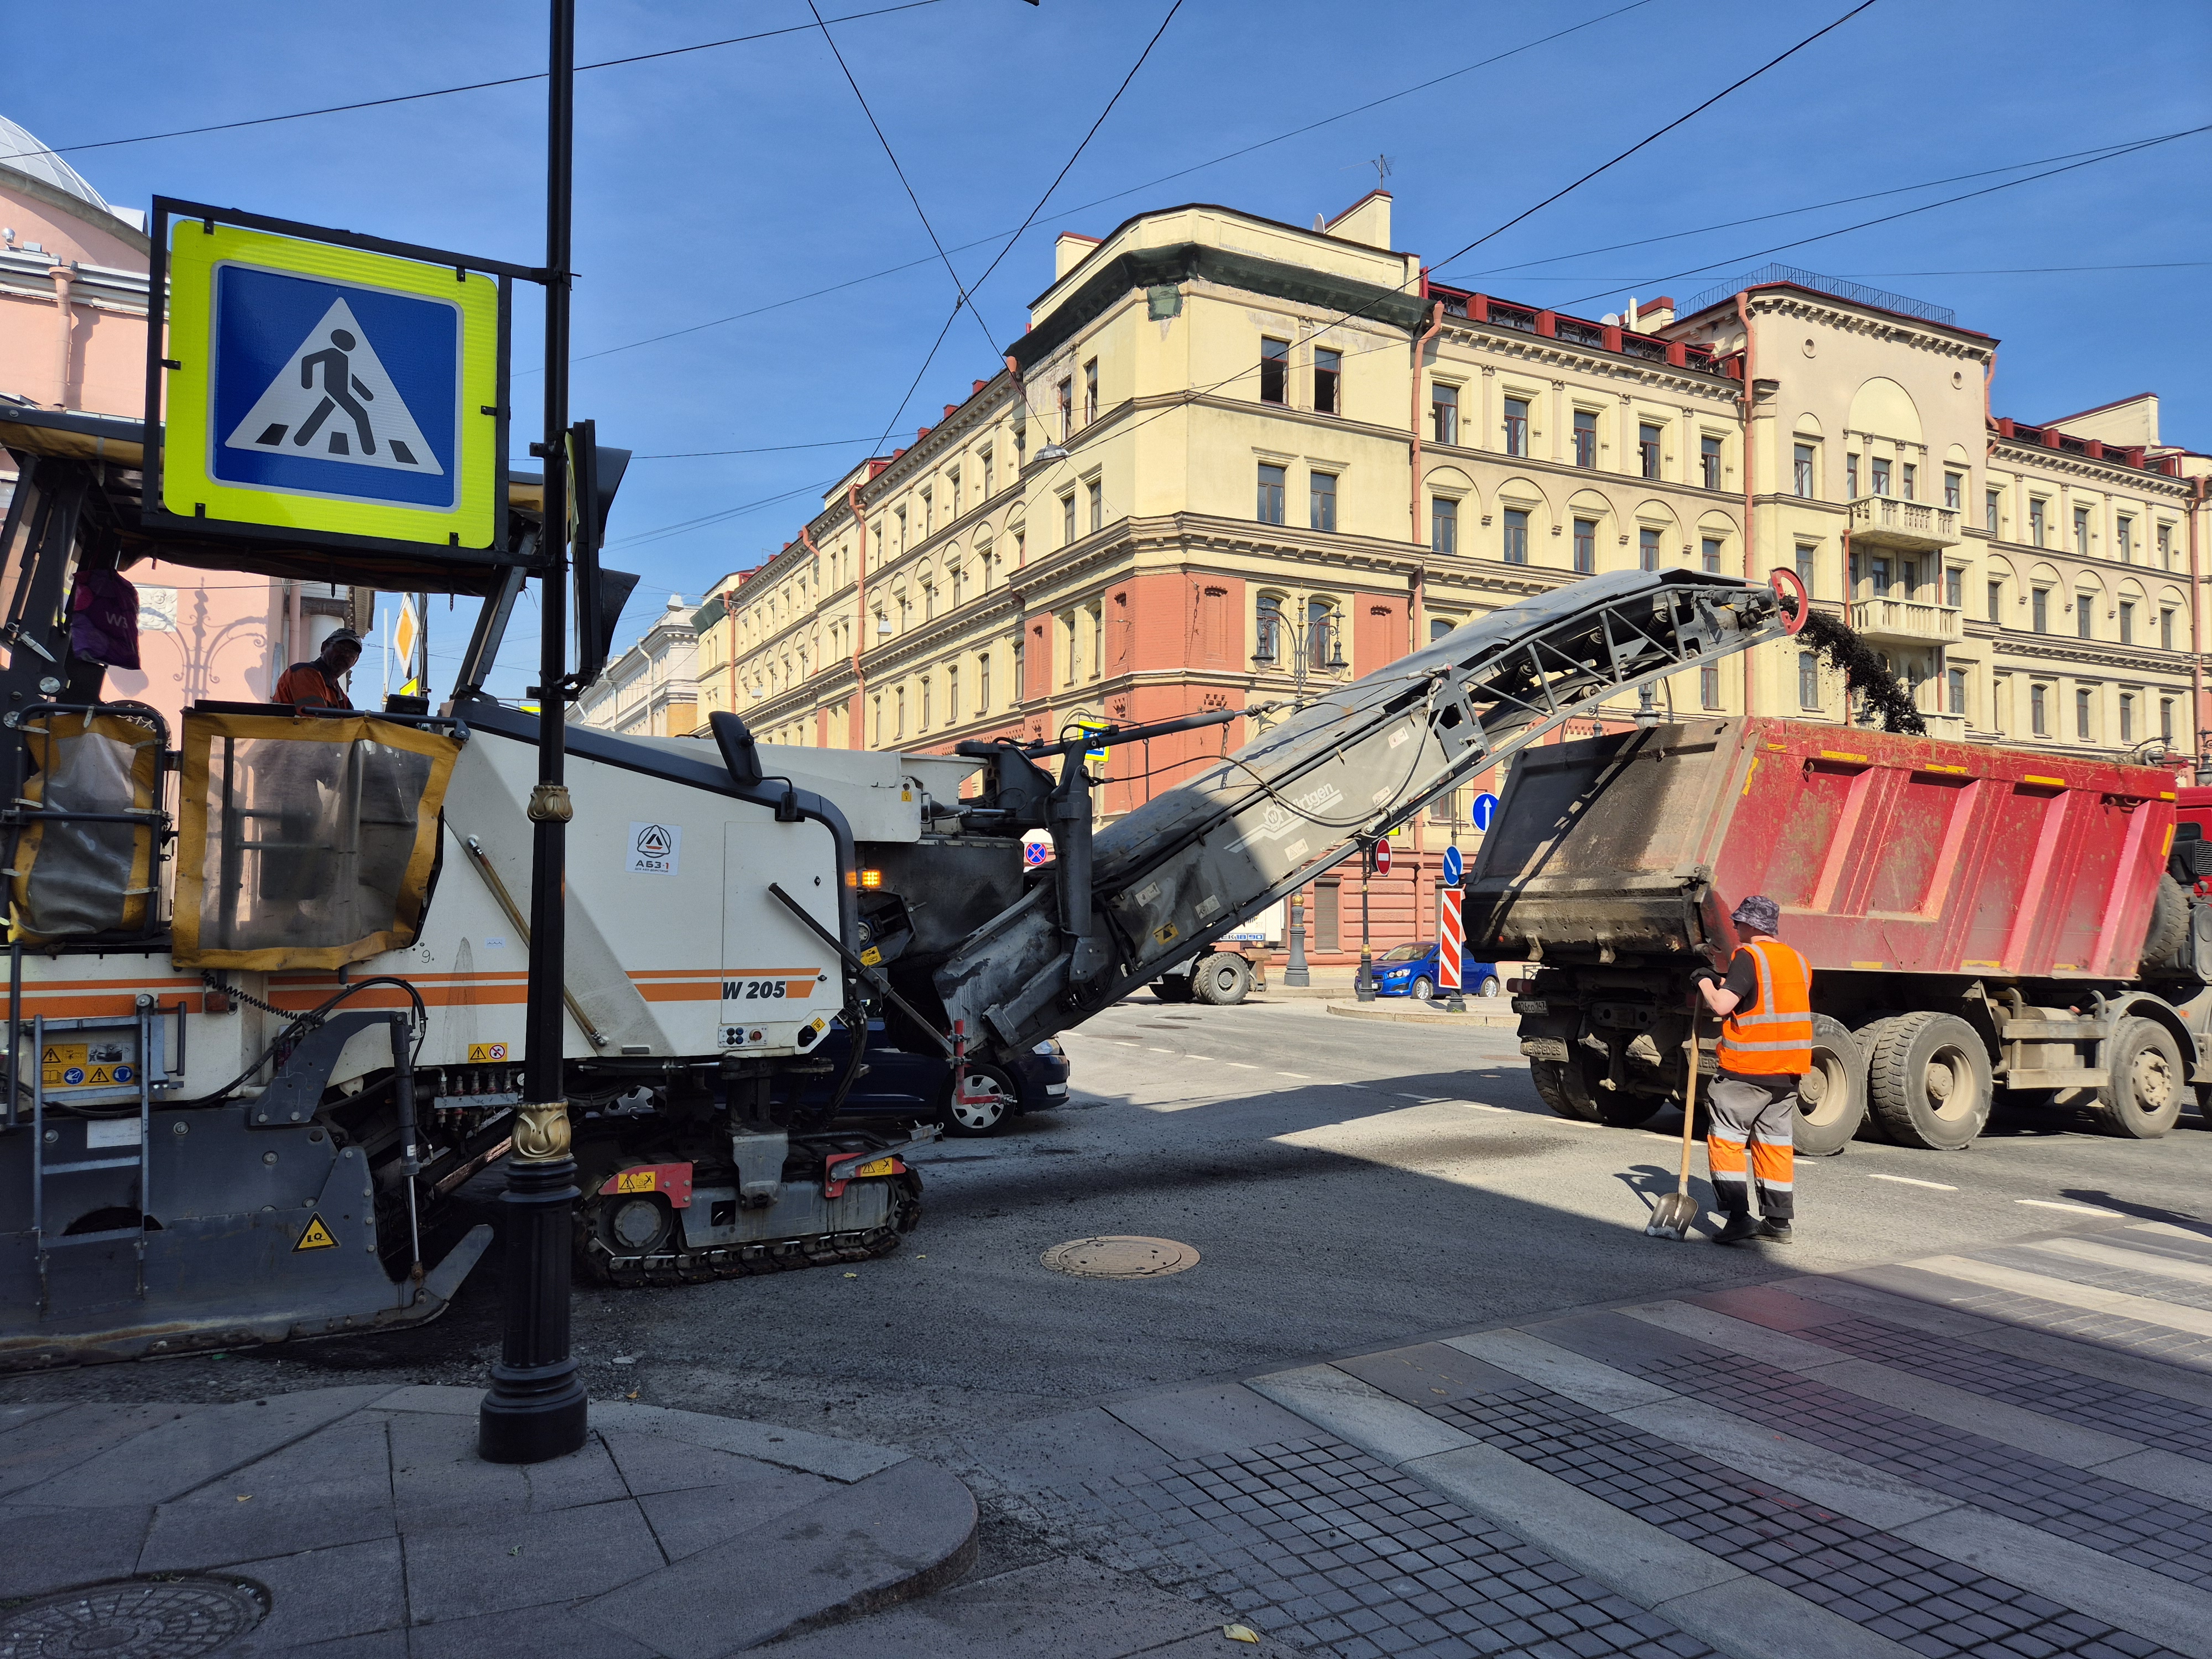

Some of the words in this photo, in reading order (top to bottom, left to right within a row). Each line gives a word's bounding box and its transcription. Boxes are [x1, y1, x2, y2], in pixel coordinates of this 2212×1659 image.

[1282, 783, 1334, 818] Wirtgen
[1268, 811, 1279, 823] W
[635, 860, 669, 870] АБЗ-1
[722, 982, 743, 999] W
[745, 980, 786, 999] 205
